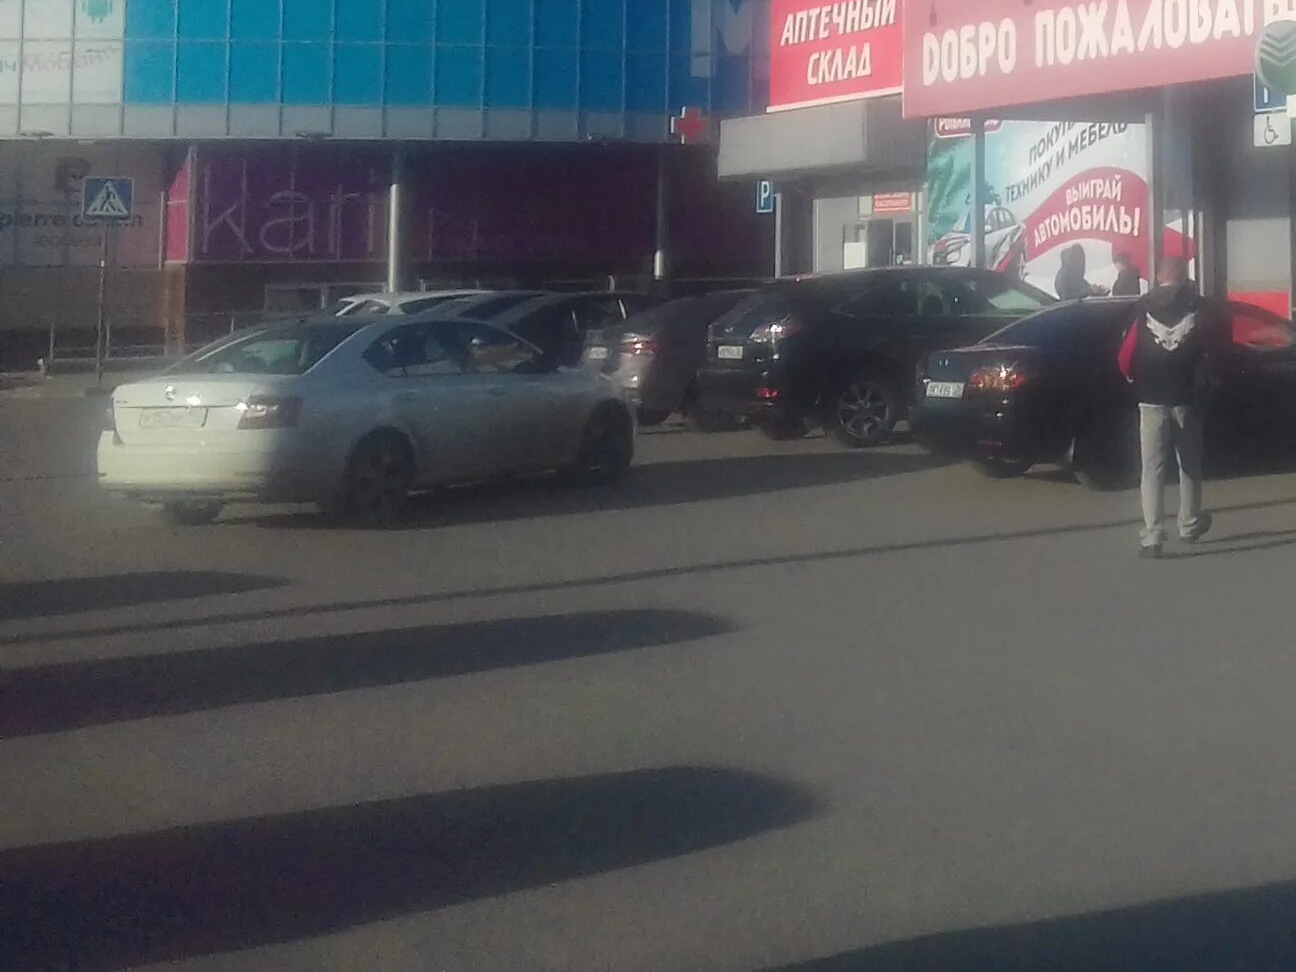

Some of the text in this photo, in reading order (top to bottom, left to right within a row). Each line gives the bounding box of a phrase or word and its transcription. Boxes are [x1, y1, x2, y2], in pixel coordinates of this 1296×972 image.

[806, 42, 872, 85] СКЛАД
[1006, 156, 1054, 204] ТЕХНИКУ
[1065, 175, 1122, 206] ВЫИГРАЙ
[203, 161, 375, 254] kari
[1034, 207, 1141, 248] АВТОМОБИЛЬ!
